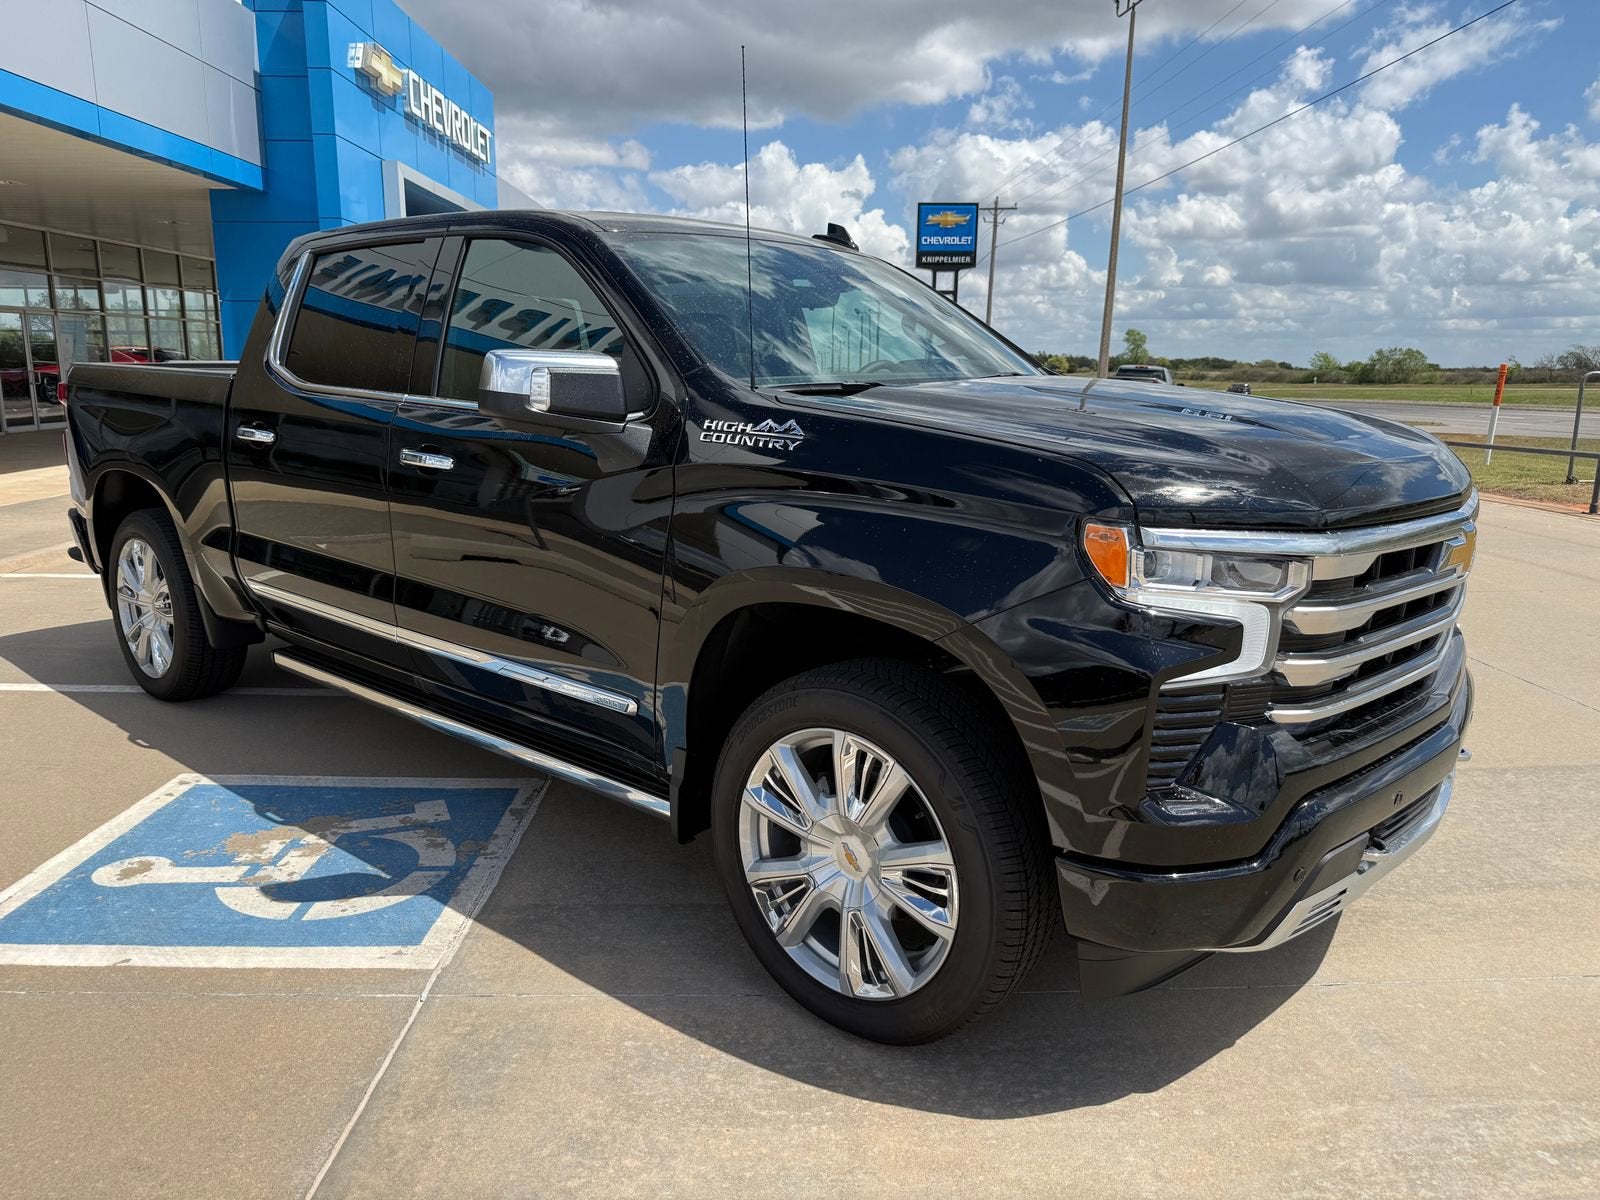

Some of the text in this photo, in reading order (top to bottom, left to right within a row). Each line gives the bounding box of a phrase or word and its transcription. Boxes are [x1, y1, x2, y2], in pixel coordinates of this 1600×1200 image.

[407, 69, 492, 165] CHEVROLET
[922, 236, 972, 245] CHEVROLET
[921, 255, 971, 264] KNIPPELMIER
[703, 419, 753, 432] HIGH
[700, 432, 803, 450] COUNTRY
